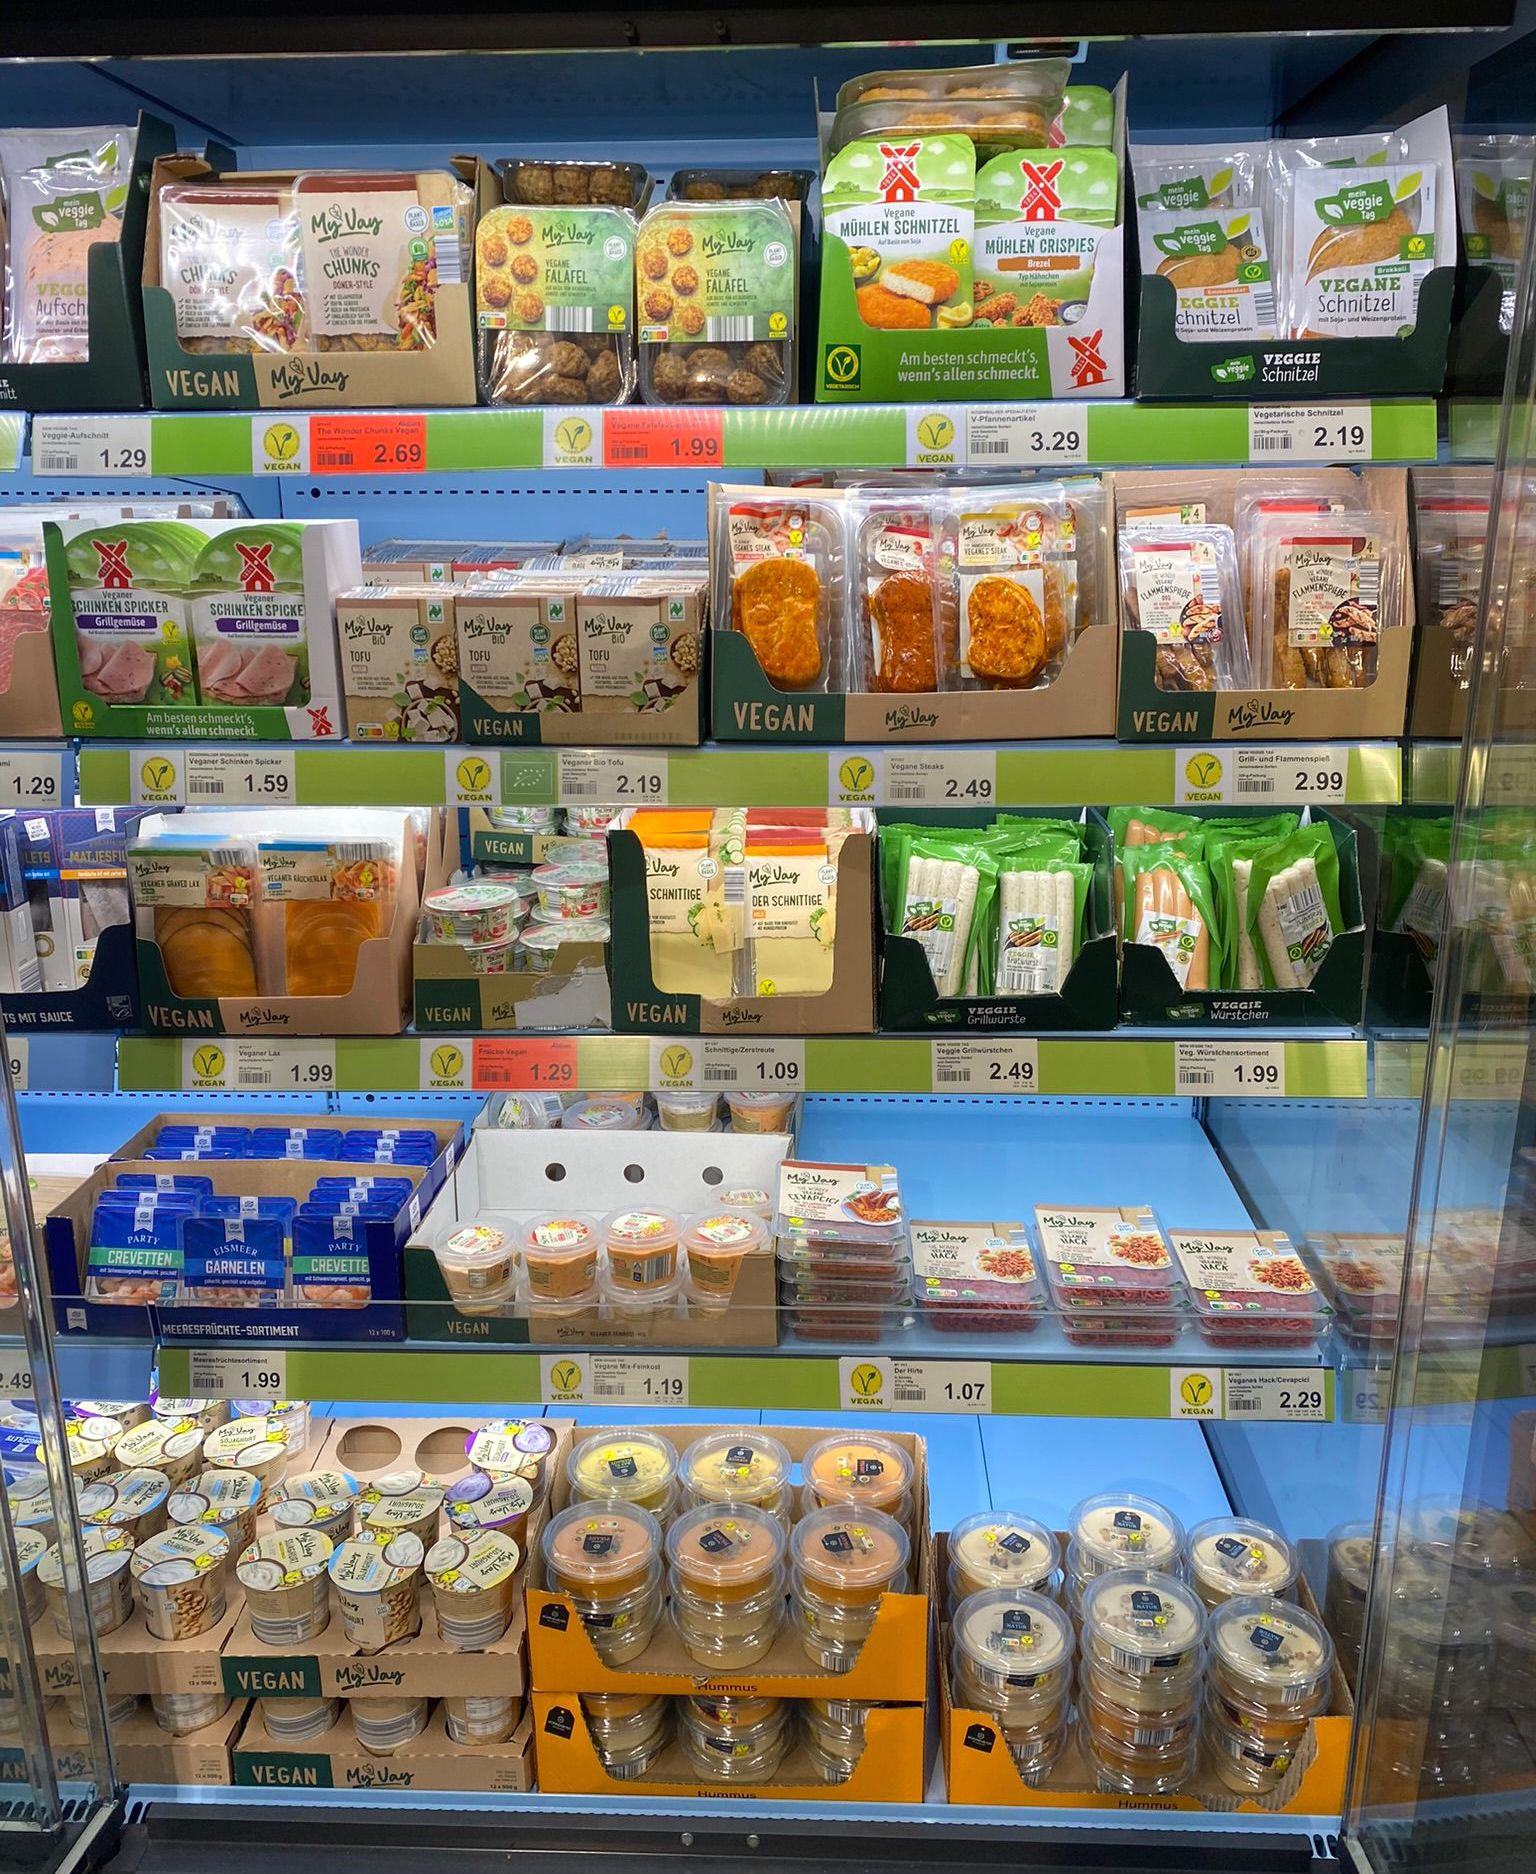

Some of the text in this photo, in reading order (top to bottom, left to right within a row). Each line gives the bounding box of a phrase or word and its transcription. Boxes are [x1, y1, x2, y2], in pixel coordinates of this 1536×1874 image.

[1348, 190, 1366, 198] mein
[1343, 195, 1382, 211] veggie
[58, 204, 94, 218] veggie
[884, 208, 915, 219] Vegane
[1361, 211, 1375, 220] Tag
[311, 207, 383, 238] My Vay
[840, 218, 960, 237] MÜHLEN SCHNITZEL
[1025, 226, 1056, 238] Vegane
[1179, 232, 1217, 245] veggie
[985, 236, 1095, 254] MÜHLEN CRISPIES
[323, 258, 380, 279] CHUNKS
[545, 259, 570, 268] VEGANE
[1027, 259, 1050, 268] Brezel
[545, 269, 588, 284] FALAFEL
[707, 268, 731, 277] VEGANE
[1018, 272, 1059, 281] Typ Hähnchen
[706, 278, 749, 293] FALAFEL
[1319, 277, 1401, 292] VEGANE
[1318, 292, 1395, 313] Schnitzel
[1361, 315, 1407, 323] Weizenprotein
[900, 349, 1039, 367] Am besten schmeckt's,
[1264, 352, 1321, 365] VEGGIE
[271, 362, 349, 395] My Vay
[898, 367, 1040, 382] wenn's allen schmeckt.
[1262, 365, 1319, 382] Schnitzel
[165, 370, 240, 396] VEGAN
[971, 415, 1036, 424] V-Pfannenartikel
[1253, 409, 1344, 419] Vegetarische Schnitzel
[42, 430, 109, 441] Veggie-Aufschnitt
[1030, 431, 1080, 451] 3.29
[1313, 425, 1365, 447] 2.19
[671, 437, 718, 457] 1.99
[99, 448, 147, 469] 1.29
[374, 444, 422, 464] 2.69
[555, 456, 593, 464] VEGAN
[918, 454, 954, 463] VEGAN
[263, 462, 301, 471] VEGAN
[1366, 541, 1373, 553] 4
[102, 590, 133, 600] Veganer
[243, 594, 274, 603] Veganer
[72, 600, 169, 614] SCHINKEN SPICKER
[210, 603, 304, 617] SCHINKEN SPICKE
[95, 616, 146, 628] Grillgemüse
[235, 619, 288, 631] Grillgemüse
[350, 651, 371, 662] TOFU
[469, 650, 491, 662] TOFU
[589, 649, 610, 661] TOFU
[147, 713, 255, 725] Am besten schmeckt's,
[147, 725, 258, 737] wenn's allen schmeckt.
[189, 757, 282, 767] Veganer Schinken Spicker
[562, 758, 624, 767] Veganer Bio Tofu
[1238, 755, 1330, 764] Grill- und Flammenspieß
[891, 763, 918, 771] Vegane
[12, 775, 55, 795] 1.29
[244, 773, 289, 793] 1.59
[616, 775, 662, 794] 2.19
[1295, 771, 1343, 791] 2.99
[945, 779, 992, 798] 2.49
[1187, 792, 1221, 800] VEGAN
[652, 857, 681, 877] Vay
[188, 880, 200, 888] LAX
[650, 888, 702, 901] SCHNITTIGE
[752, 894, 823, 907] DER SCHNITTIGE
[968, 1006, 1017, 1015] VEGGIE
[1212, 1001, 1262, 1009] VEGGIE
[18, 1012, 37, 1023] MIT
[40, 1011, 74, 1023] SAUCE
[425, 1007, 471, 1022] VEGAN
[1210, 1009, 1269, 1020] Würstchen
[239, 1050, 266, 1058] Veganer
[705, 1046, 775, 1054] Schnittige/Zerstreute
[1179, 1049, 1269, 1057] Veg. Würstchensortiment
[290, 1064, 333, 1082] 1.99
[530, 1063, 572, 1081] 1.29
[756, 1061, 799, 1080] 1.09
[989, 1062, 1034, 1080] 2.49
[1234, 1065, 1278, 1083] 1.99
[127, 1234, 161, 1245] PARTY
[213, 1244, 258, 1257] EISMEER
[328, 1242, 361, 1253] PARTY
[107, 1250, 173, 1266] CREVETTEN
[205, 1260, 265, 1275] GARNELEN
[311, 1258, 369, 1273] CREVETTE
[162, 1323, 300, 1337] MEERESFRÜCHTE-SORTIMENT
[620, 1362, 661, 1370] Mix-Feinkost
[241, 1372, 280, 1388] 1.99
[643, 1378, 683, 1395] 1.19
[944, 1383, 985, 1400] 1.07
[1280, 1391, 1322, 1409] 2.29
[237, 1670, 304, 1690] VEGAN
[336, 1667, 405, 1688] My Vay
[698, 1684, 758, 1692] Hummus
[697, 1790, 757, 1798] Hummus
[1118, 1800, 1178, 1810] Hummus
